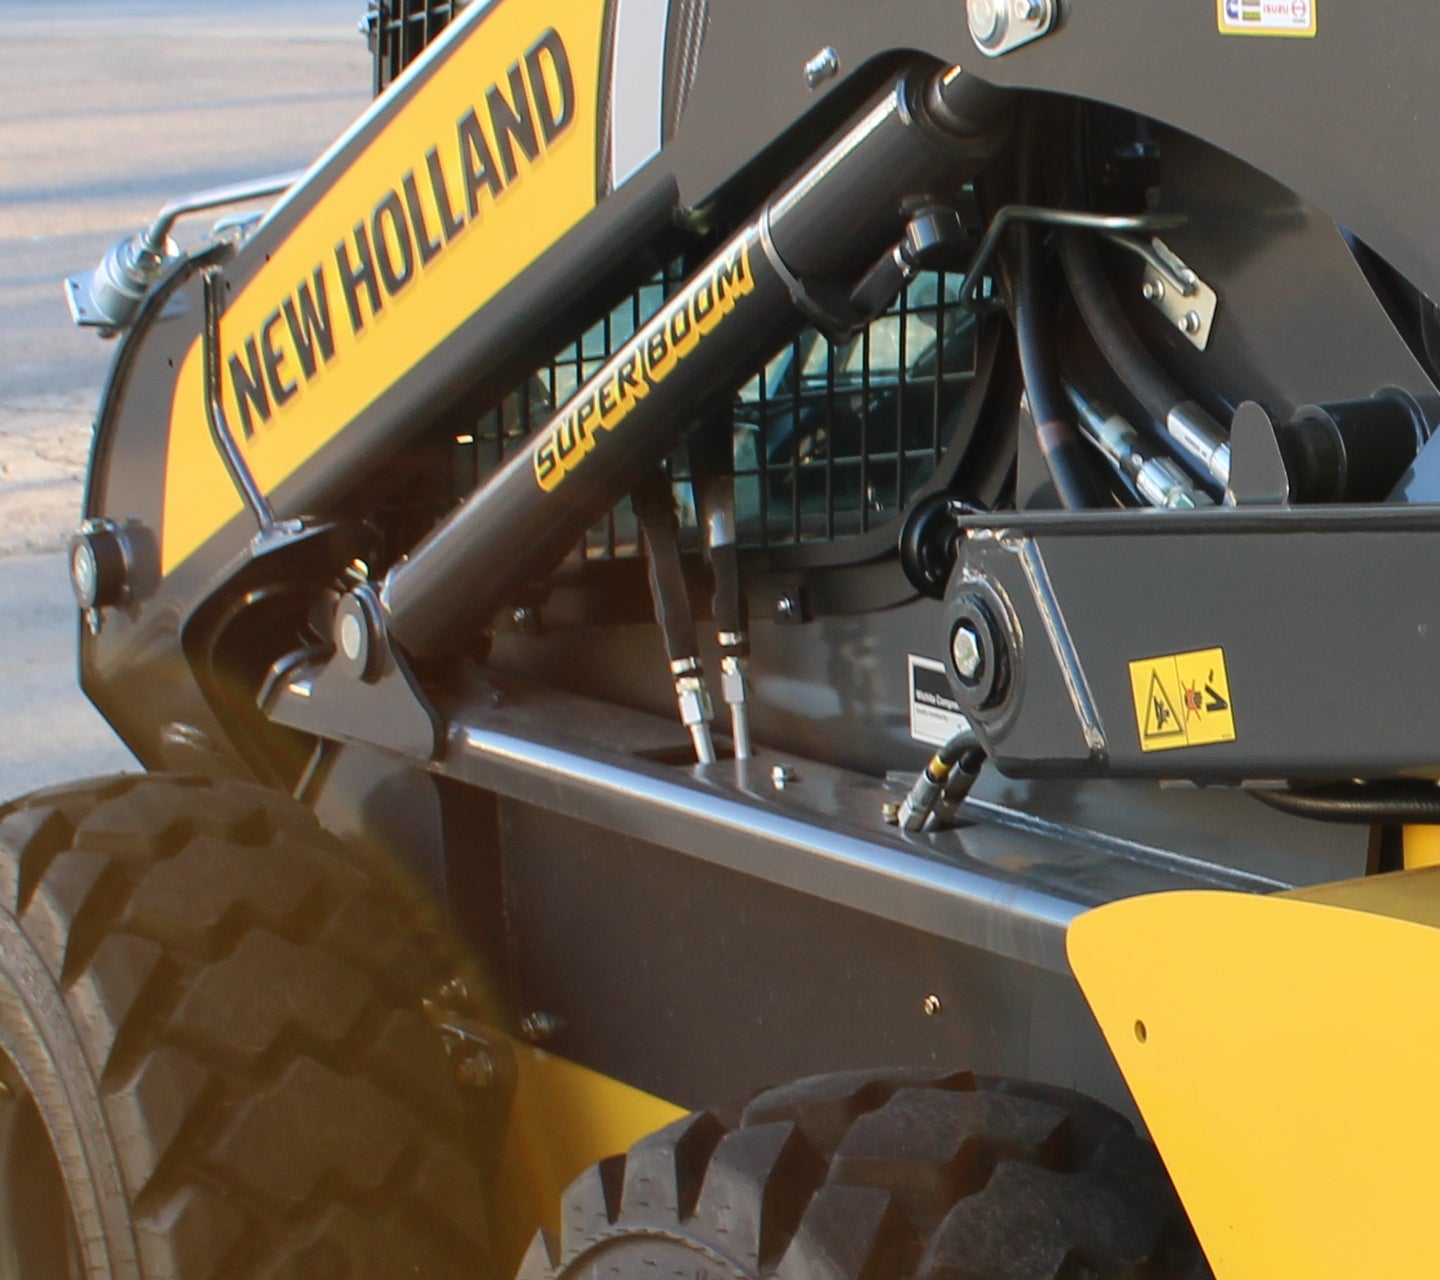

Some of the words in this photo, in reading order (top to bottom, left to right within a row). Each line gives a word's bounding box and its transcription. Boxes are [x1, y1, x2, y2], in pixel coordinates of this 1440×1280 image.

[1263, 3, 1289, 15] ISUZU
[227, 263, 336, 440] NEW
[334, 26, 576, 334] HOLLAND
[535, 348, 649, 492] SUPER
[645, 237, 755, 382] BOOM
